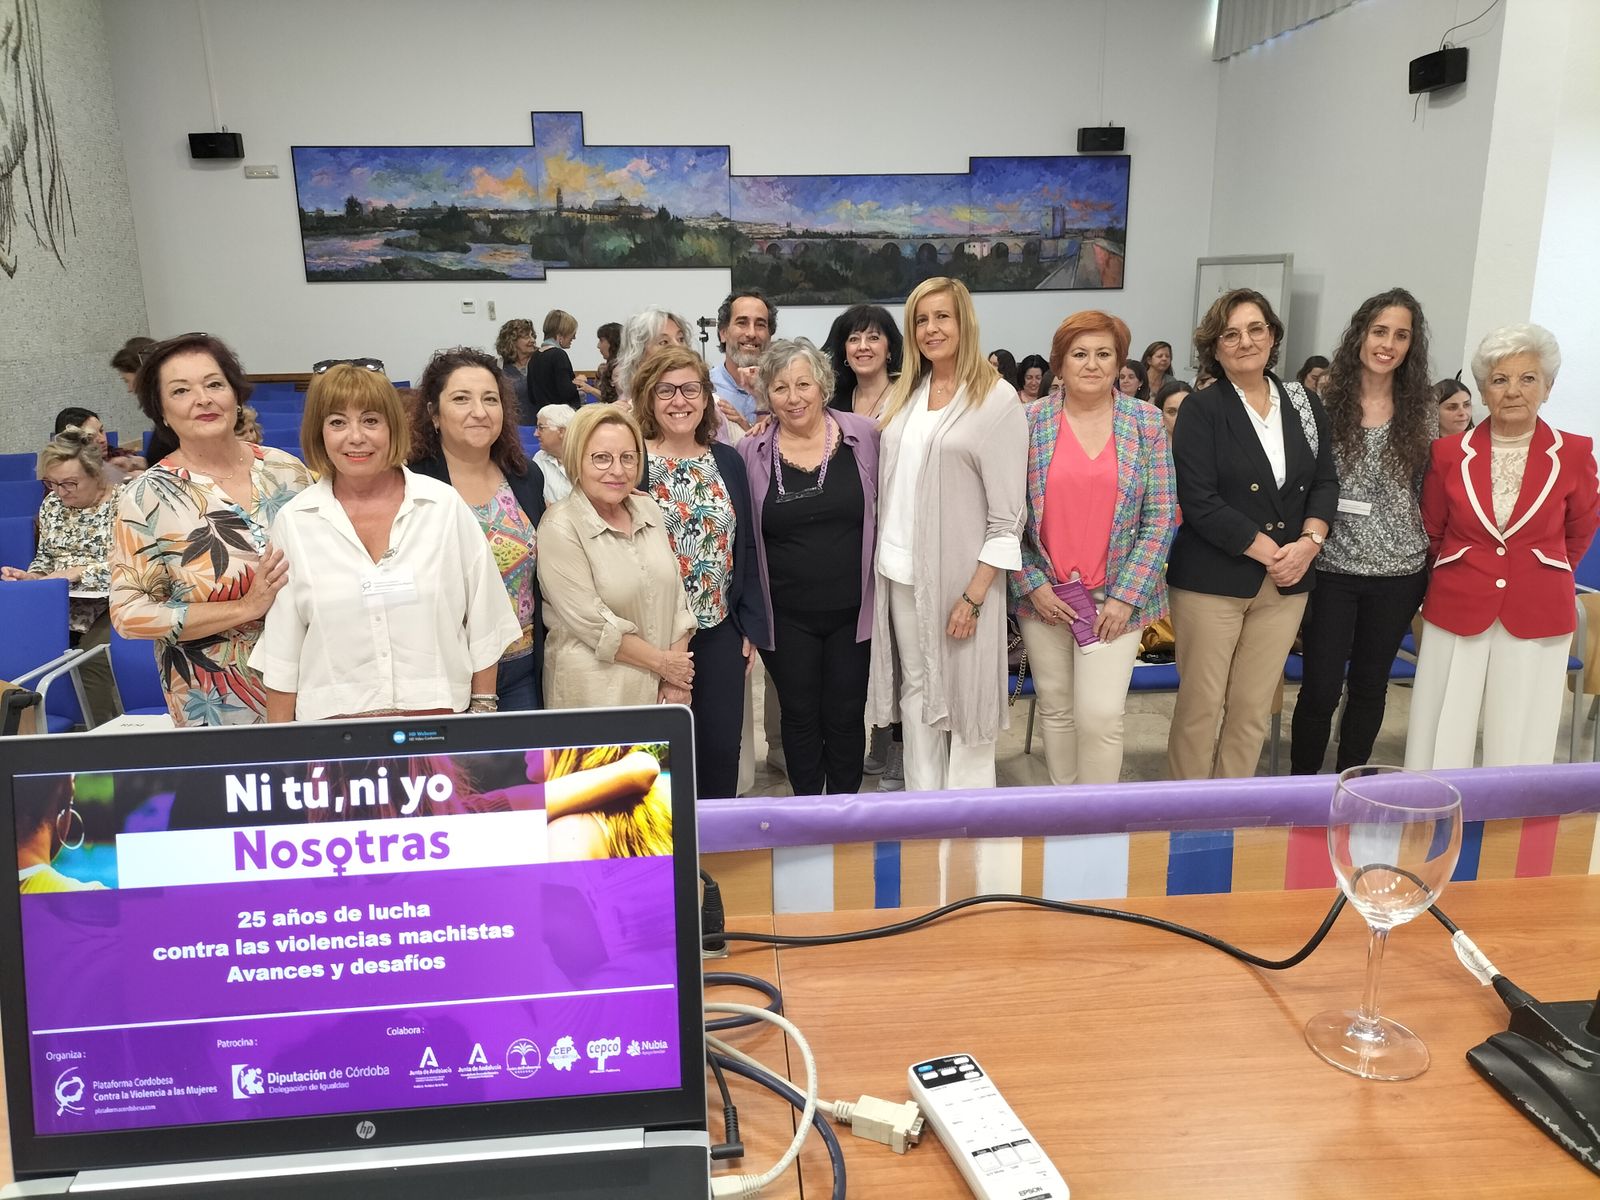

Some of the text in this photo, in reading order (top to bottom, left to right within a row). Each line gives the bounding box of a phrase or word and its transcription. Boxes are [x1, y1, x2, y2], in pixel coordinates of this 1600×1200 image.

[225, 773, 272, 813] Ni
[400, 774, 453, 815] yo
[233, 830, 450, 877] Nosotras
[237, 901, 431, 928] 25 años de lucha
[152, 922, 515, 960] contra las violencias machistas
[226, 953, 447, 983] Avances y desafíos
[553, 1046, 572, 1055] CEP
[589, 1042, 619, 1056] cepco
[641, 1039, 668, 1050] Nubia
[92, 1076, 174, 1090] Plataforma Cordobesa
[267, 1064, 390, 1085] Diputación de Córdoba
[93, 1090, 121, 1101] Contra
[121, 1090, 129, 1099] la
[129, 1088, 166, 1099] Violencia
[173, 1086, 185, 1095] las
[186, 1084, 218, 1096] Mujeres
[268, 1085, 308, 1095] Delegación
[319, 1081, 350, 1092] Igualdad
[358, 1120, 374, 1139] hp
[1018, 1186, 1043, 1196] EPSON
